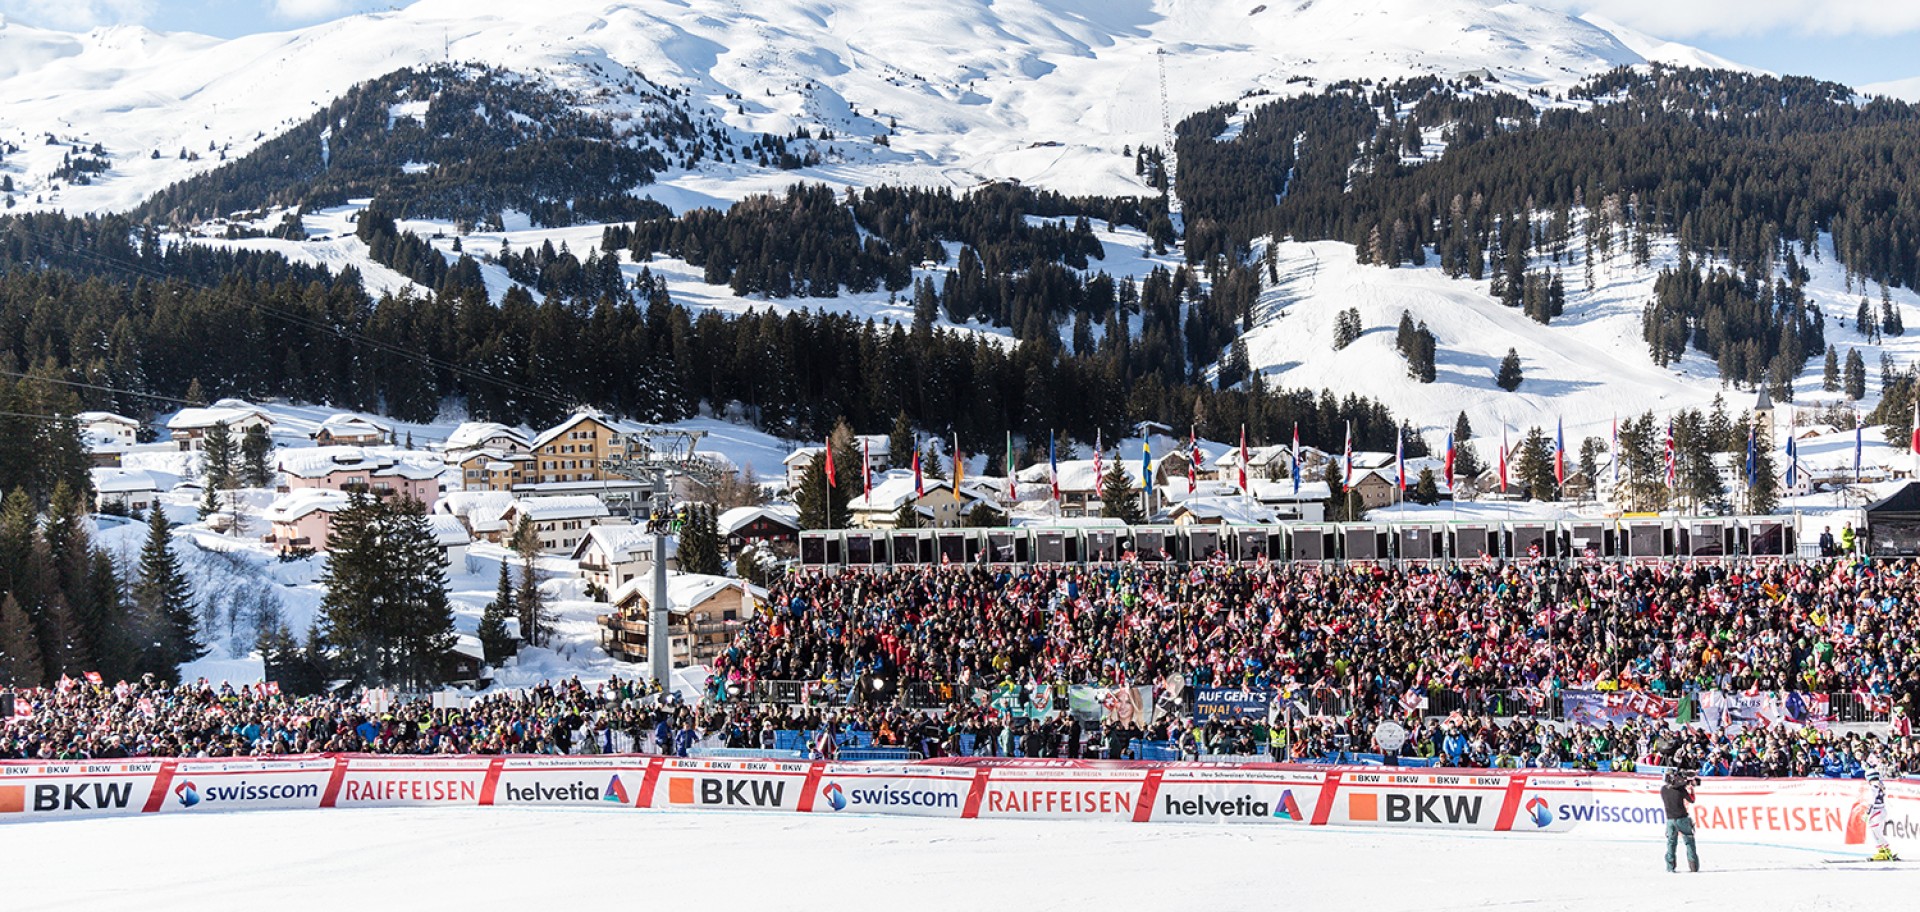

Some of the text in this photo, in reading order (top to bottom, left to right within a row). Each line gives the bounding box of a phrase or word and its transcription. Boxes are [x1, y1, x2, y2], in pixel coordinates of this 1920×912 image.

[1197, 691, 1267, 703] AUF GEHT'S
[1197, 704, 1230, 715] TINA!
[46, 766, 70, 774] BKW
[711, 761, 732, 769] BKW
[206, 781, 318, 801] swisscom
[345, 780, 476, 801] RAIFFEISEN
[506, 781, 600, 801] helvetia
[1357, 775, 1501, 785] BKW BKW BKW BKW
[33, 782, 133, 811] BKW
[701, 778, 786, 807] BKW
[851, 784, 958, 808] swisscom
[988, 790, 1131, 813] RAIFFEISEN
[1166, 794, 1269, 817] helvetia
[1386, 794, 1483, 824] BKW
[1558, 799, 1665, 824] swisscom
[1693, 805, 1843, 832] RAIFFEISEN
